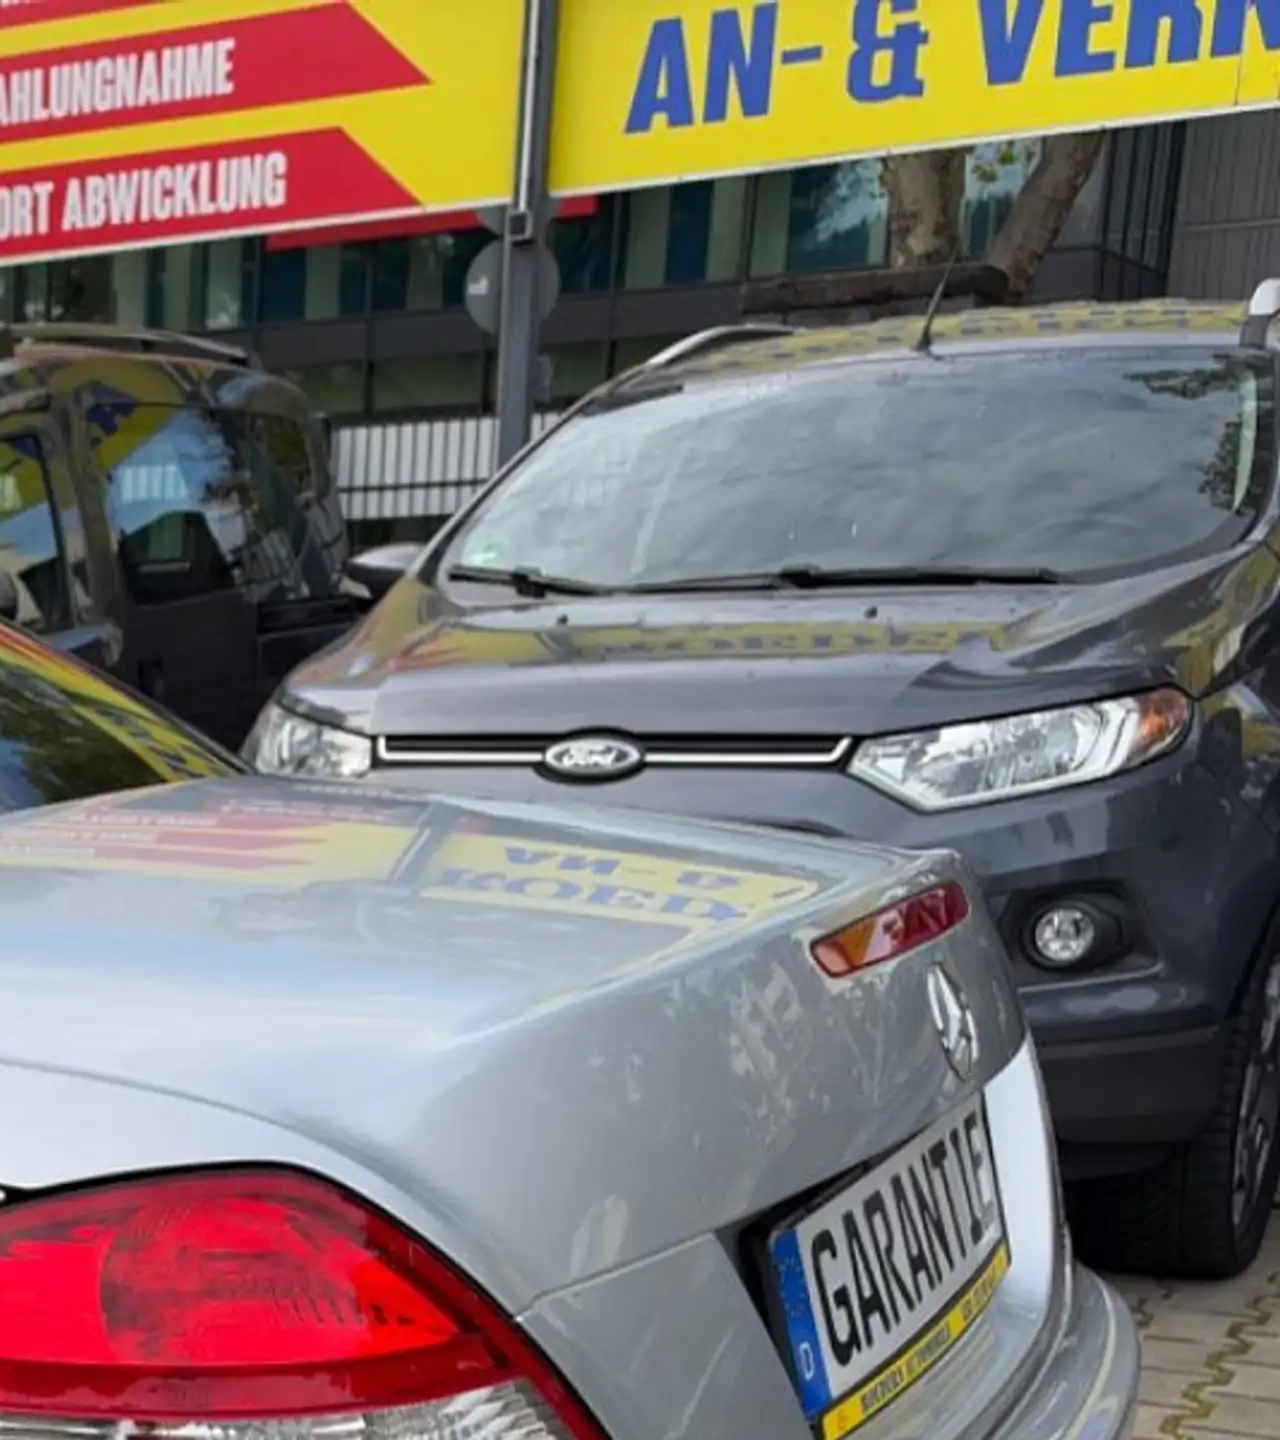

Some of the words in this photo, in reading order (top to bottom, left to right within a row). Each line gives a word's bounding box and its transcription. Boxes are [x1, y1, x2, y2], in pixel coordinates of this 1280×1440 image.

[625, 2, 823, 133] AN-
[846, 0, 929, 102] &
[62, 152, 288, 232] ABWICKLUNG
[561, 745, 619, 767] Ford
[811, 1111, 994, 1366] GARANTIE
[798, 1341, 815, 1381] D
